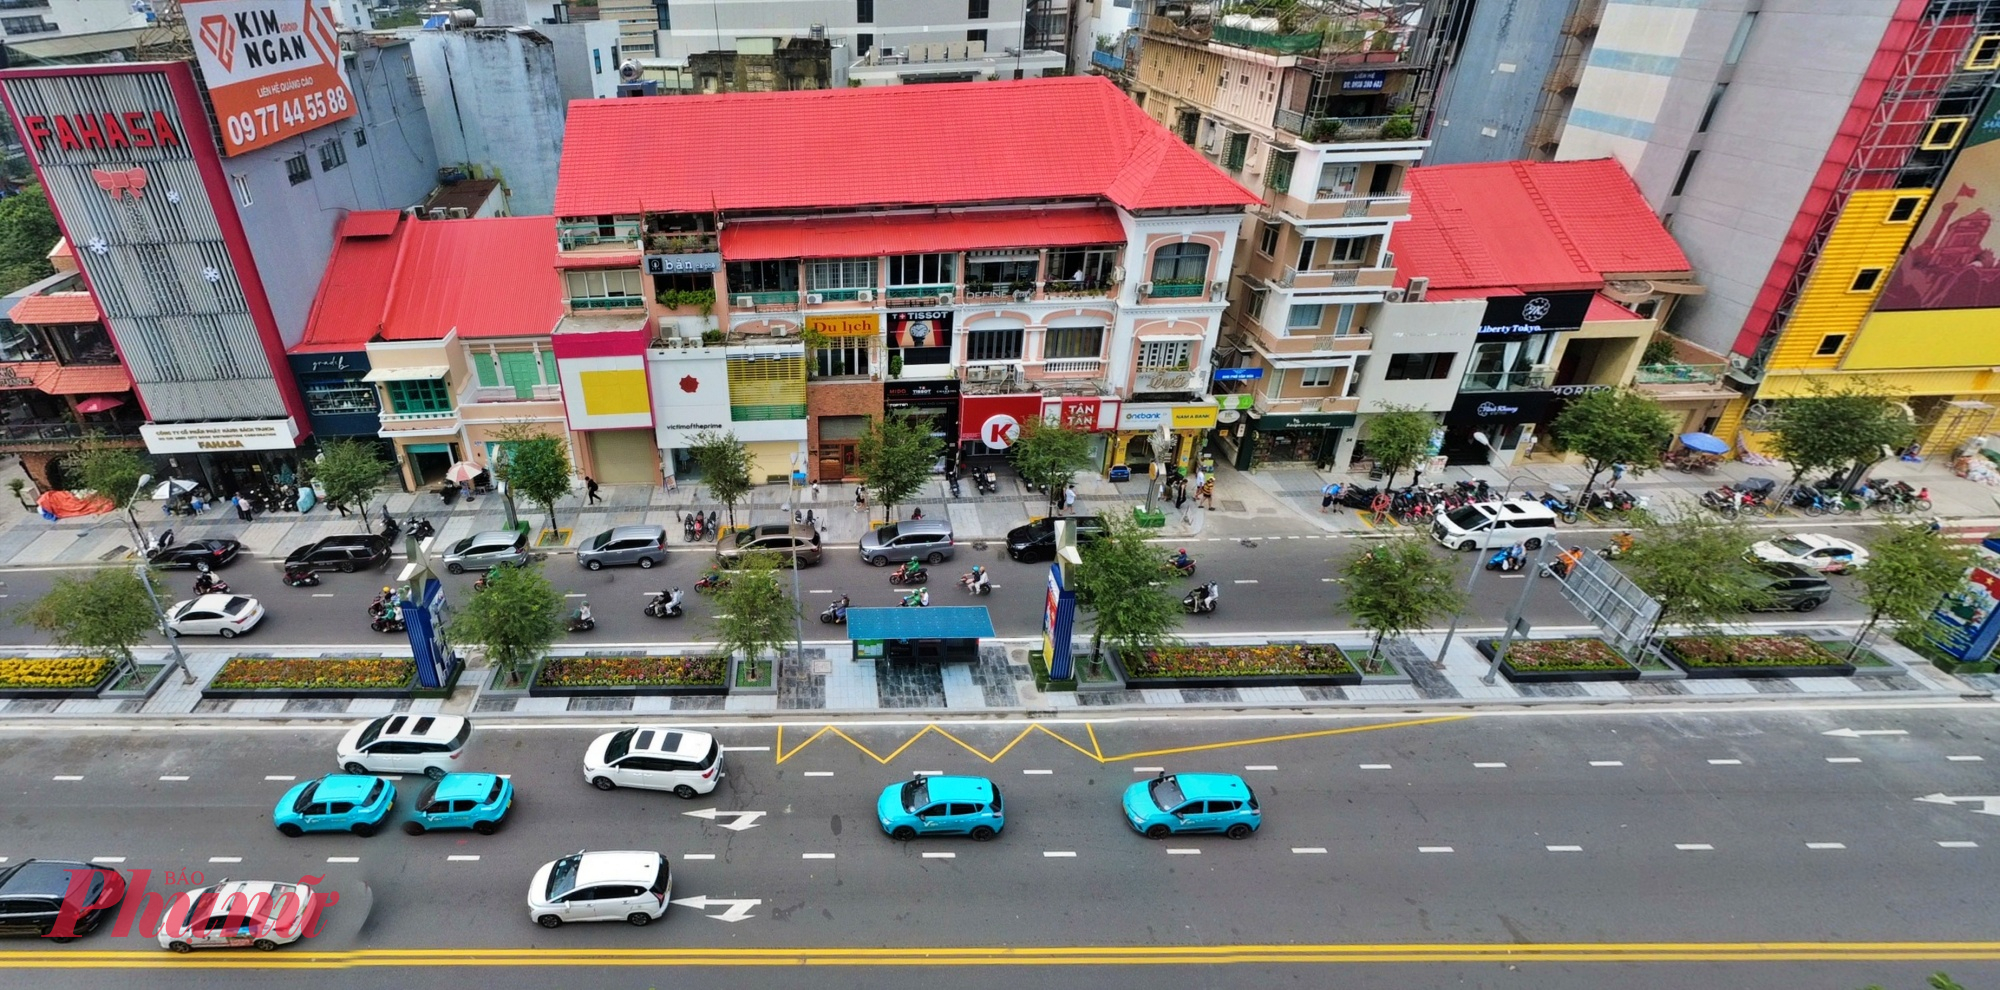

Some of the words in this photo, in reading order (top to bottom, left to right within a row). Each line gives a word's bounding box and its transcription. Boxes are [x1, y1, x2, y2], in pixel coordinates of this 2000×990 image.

[235, 9, 281, 39] KIM
[280, 22, 298, 33] GROUP
[244, 35, 307, 68] NGAN
[257, 86, 272, 98] LIÊN
[271, 83, 280, 95] HỆ
[280, 79, 301, 93] QUẢNG
[301, 76, 314, 87] CÁO
[227, 112, 256, 146] 09
[254, 103, 279, 137] 77
[282, 97, 305, 127] 44
[304, 91, 327, 121] 55
[326, 86, 348, 114] 88
[24, 110, 179, 150] FAHASA
[665, 258, 693, 270] bản
[966, 291, 1007, 300] DEFINE
[814, 322, 836, 333] Du
[842, 320, 872, 333] lịch
[1478, 325, 1511, 333] Liberty
[1068, 403, 1094, 414] TÂN
[991, 424, 1013, 447] K
[198, 440, 244, 449] FAHASA
